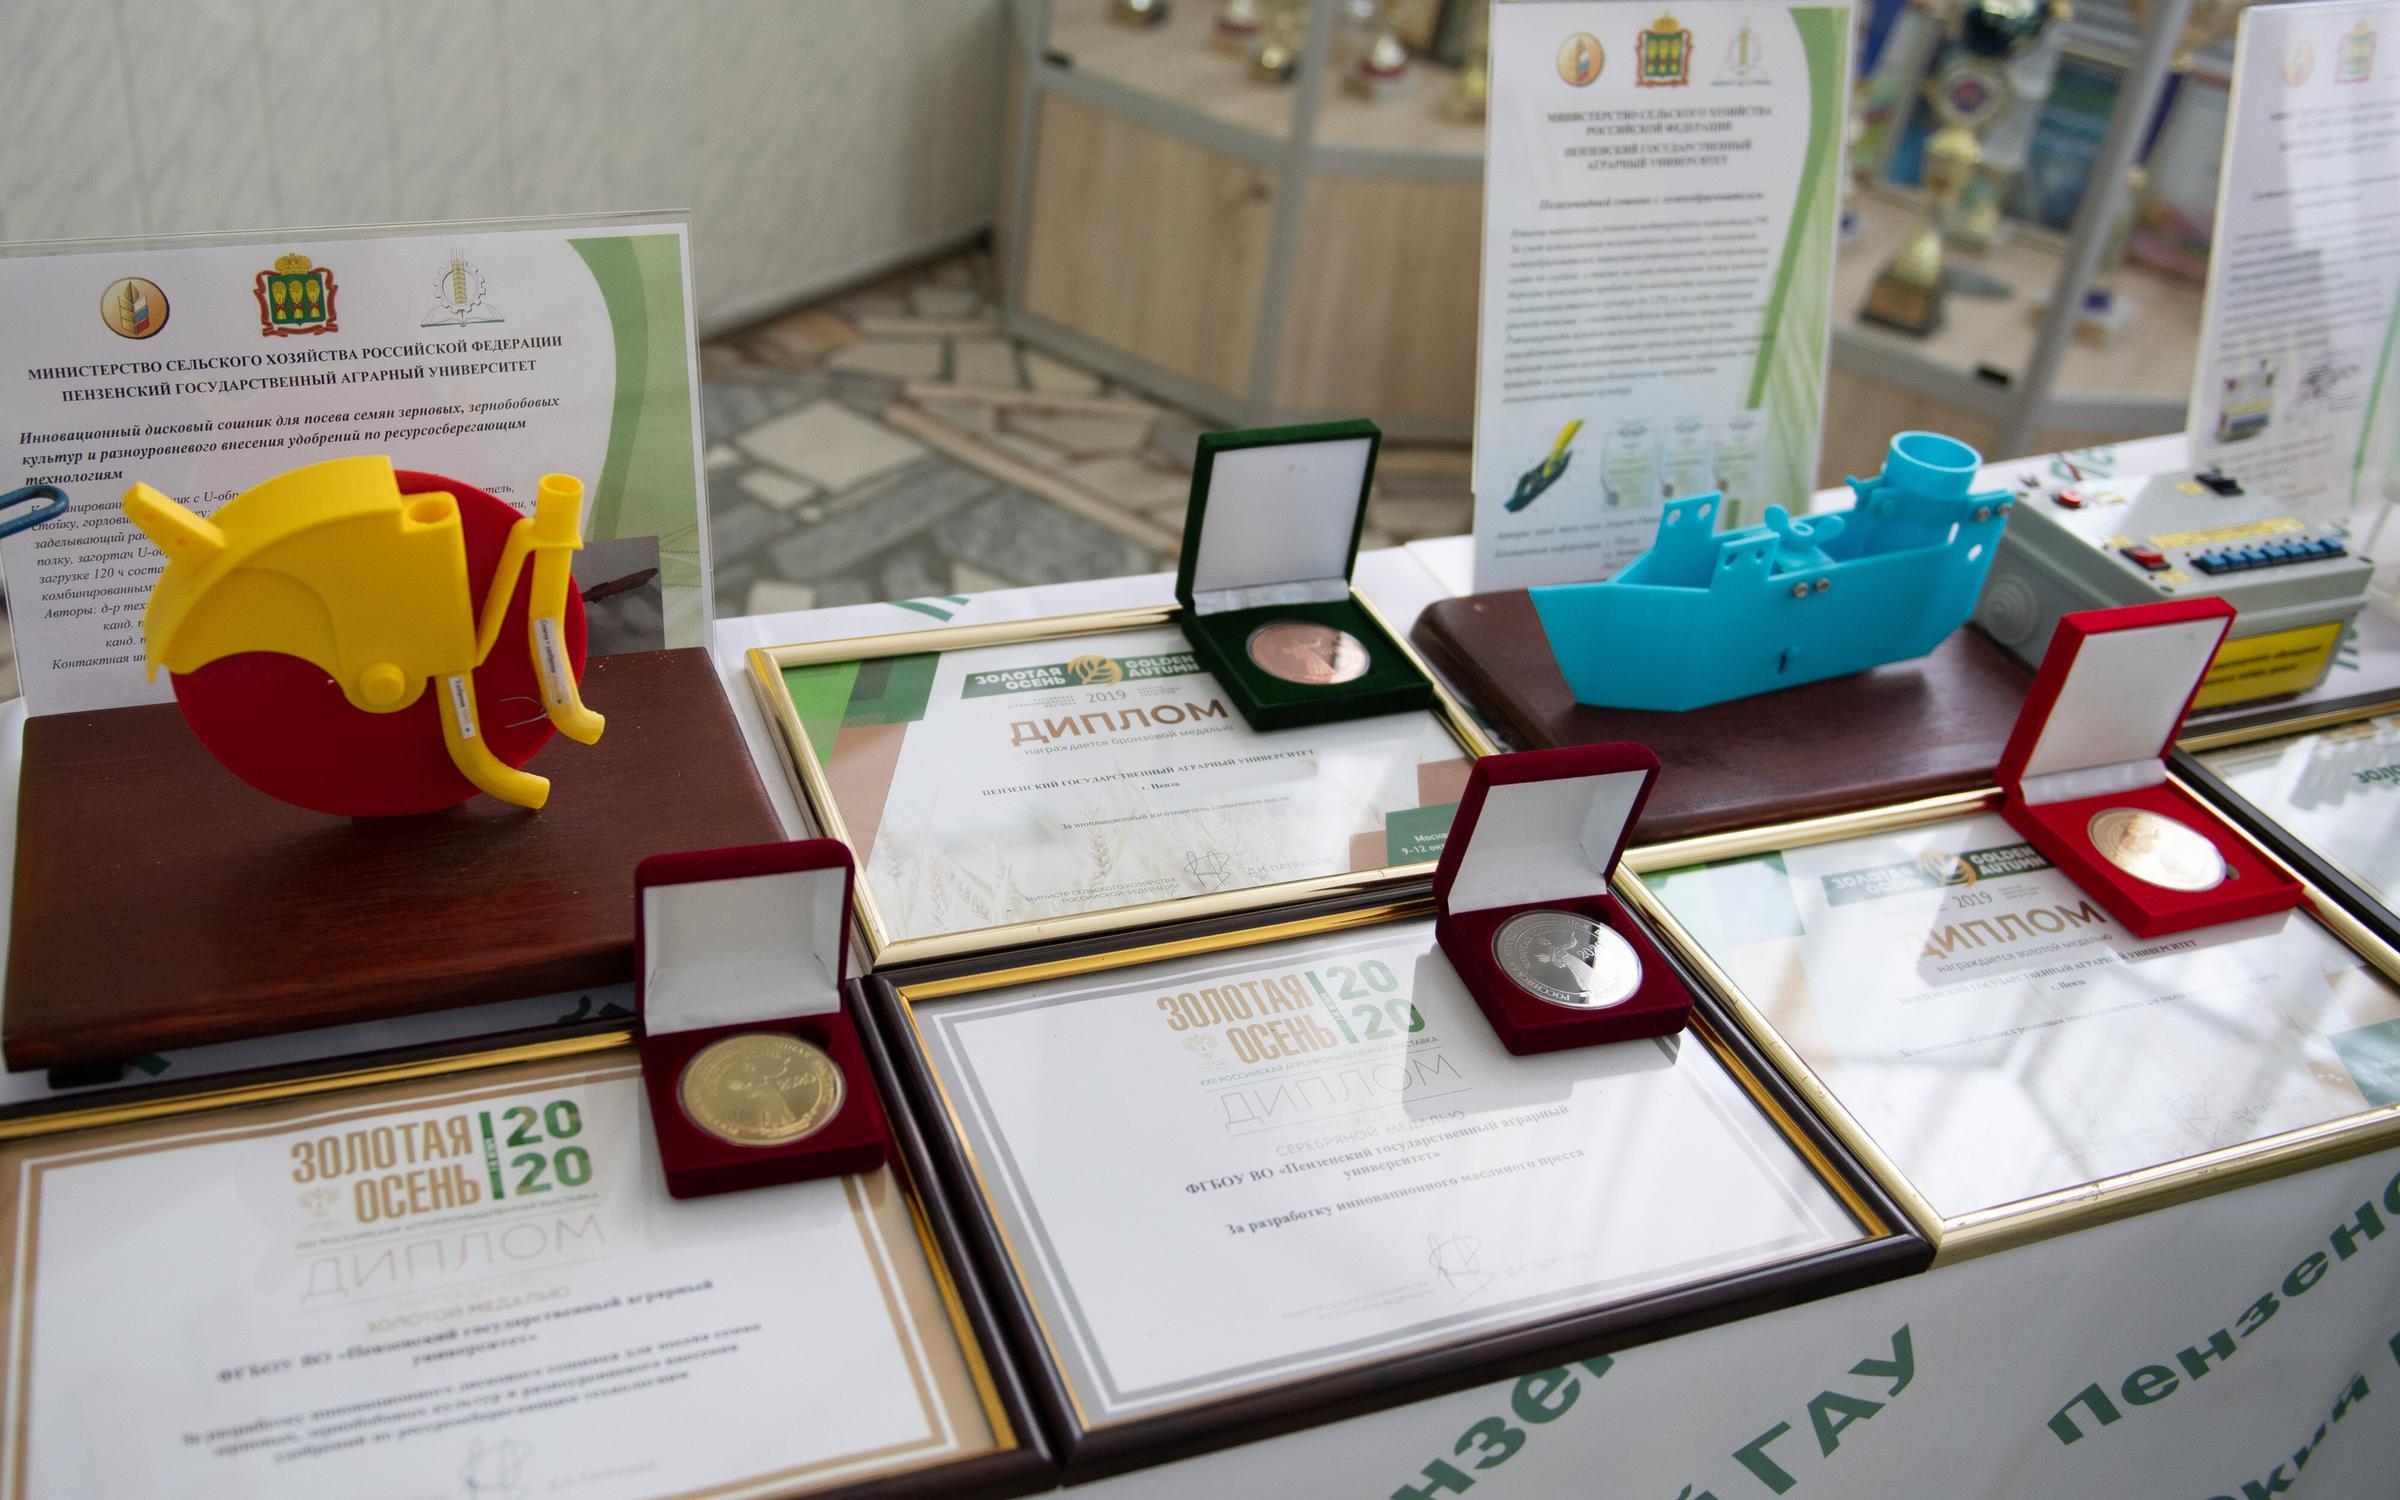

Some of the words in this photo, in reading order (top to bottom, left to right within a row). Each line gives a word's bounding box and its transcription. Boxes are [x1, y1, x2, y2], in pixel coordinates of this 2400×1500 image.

[28, 361, 162, 381] МИНИСТЕРСТВО
[166, 354, 262, 372] СЕЛЬСКОГО
[266, 348, 358, 366] ХОЗЯЙСТВА
[362, 340, 467, 359] РОССИЙСКОЙ
[471, 336, 563, 352] ФЕДЕРАЦИИ
[62, 381, 171, 402] ПЕНЗЕНСКИЙ
[175, 370, 337, 396] ГОСУДАРСТВЕННЫЙ
[341, 365, 425, 383] АГРАРНЫЙ
[429, 359, 537, 378] УНИВЕРСИТЕТ
[19, 424, 141, 445] Инновационный
[145, 419, 213, 437] дисковый
[217, 416, 272, 431] сошник
[276, 413, 300, 428] для
[304, 412, 350, 425] посева
[354, 409, 395, 421] семян
[399, 403, 465, 422] зерновых,
[468, 396, 560, 417] зернобобовых
[22, 450, 83, 466] культур
[87, 451, 96, 461] и
[100, 441, 217, 463] разноуровневого
[221, 437, 285, 450] внесения
[288, 429, 360, 448] удобрений
[364, 429, 381, 441] по
[384, 419, 527, 442] ресурсосберегающим
[25, 469, 123, 486] технологиям
[34, 531, 125, 550] заделывающий
[36, 555, 74, 568] полку,
[78, 552, 133, 566] загортач
[39, 572, 90, 585] загрузке
[94, 567, 114, 579] 120
[118, 570, 124, 578] ч
[128, 565, 165, 576] соста
[41, 583, 154, 602] комбинированным
[44, 606, 97, 620] Авторы:
[101, 602, 120, 615] д-р
[103, 619, 134, 631] канд.
[105, 636, 136, 648] канд.
[52, 654, 129, 670] Контактная
[975, 666, 1062, 685] ЗОЛОТАЯ
[1125, 654, 1195, 669] GOLDEN
[1128, 662, 1201, 678] AUTUMN
[1005, 675, 1066, 690] ОСЕНЬ
[1085, 689, 1127, 703] 2019
[1010, 698, 1229, 747] ДИПЛОМ
[1025, 737, 1111, 756] награждается
[1112, 730, 1176, 746] бронзовой
[1180, 724, 1234, 738] медалью
[982, 780, 1060, 797] ПЕНЗЕНСКИЙ
[1061, 767, 1175, 788] ГОСУДАРСТВЕННЫЙ
[1177, 758, 1237, 773] АГРАРНЫЙ
[1239, 749, 1315, 765] УНИВЕРСИТЕТ
[1969, 844, 2039, 865] GOLDEN
[1979, 854, 2048, 876] AUTUMN
[1831, 867, 1916, 889] ЗОЛОТАЯ
[1866, 878, 1924, 896] ОСЕНЬ
[1952, 890, 1993, 910] 2019
[1937, 949, 2015, 974] награждается
[2017, 941, 2062, 959] золотой
[2063, 932, 2113, 951] медалью
[2128, 939, 2197, 960] УНИВЕРСИТЕТ
[1326, 959, 1398, 1001] 20
[1156, 973, 1314, 1032] ЗОЛОТАЯ
[1351, 998, 1426, 1041] 20
[1225, 1014, 1339, 1065] ОСЕНЬ
[1220, 1053, 1463, 1132] ДИПЛОМ
[502, 1100, 582, 1148] 20
[1276, 1126, 1380, 1157] СЕРЕБРЯНОЙ
[1385, 1109, 1465, 1134] МЕДАЛЬЮ
[291, 1114, 473, 1184] ЗОЛОТАЯ
[1185, 1173, 1244, 1194] ФГБОУ
[1250, 1167, 1274, 1182] ВО
[1279, 1147, 1373, 1175] «Пензенский
[1376, 1120, 1498, 1156] государственный
[1501, 1104, 1569, 1129] аграрный
[1343, 1150, 1440, 1180] университет»
[510, 1146, 592, 1196] 20
[353, 1163, 481, 1224] ОСЕНЬ
[1225, 1223, 1245, 1235] За
[1249, 1205, 1332, 1233] разработку
[1336, 1176, 1458, 1211] инновационного
[1460, 1160, 1535, 1184] масляного
[1537, 1148, 1584, 1166] пресса
[302, 1213, 606, 1306] ДИПЛОМ
[1731, 1322, 1915, 1496] ГАУ
